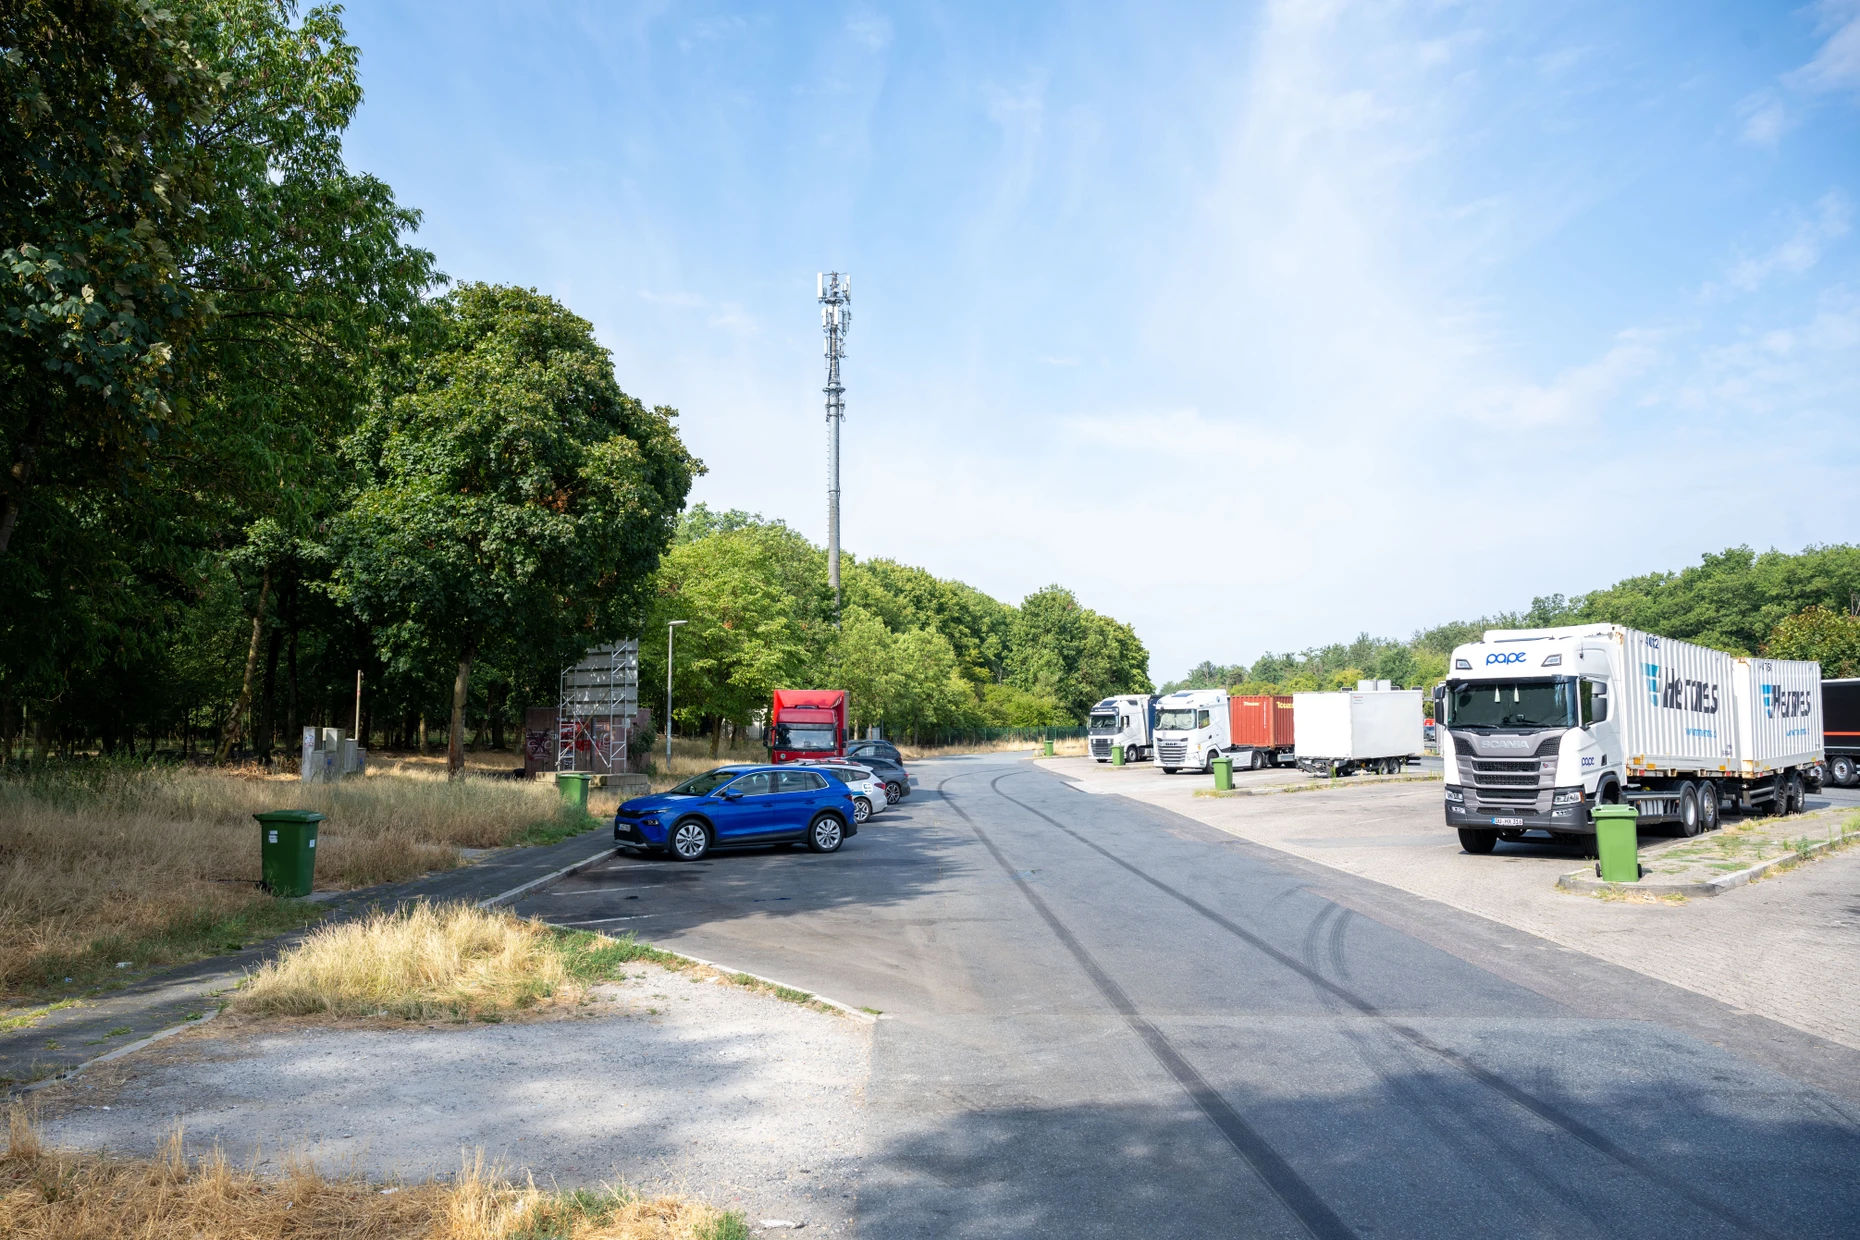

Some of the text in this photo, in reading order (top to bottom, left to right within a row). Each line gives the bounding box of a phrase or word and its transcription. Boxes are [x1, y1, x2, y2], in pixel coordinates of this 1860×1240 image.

[1486, 652, 1526, 666] pape
[1663, 667, 1718, 714] Hermes
[1770, 685, 1811, 719] Hermes
[1481, 740, 1530, 749] SCANIA
